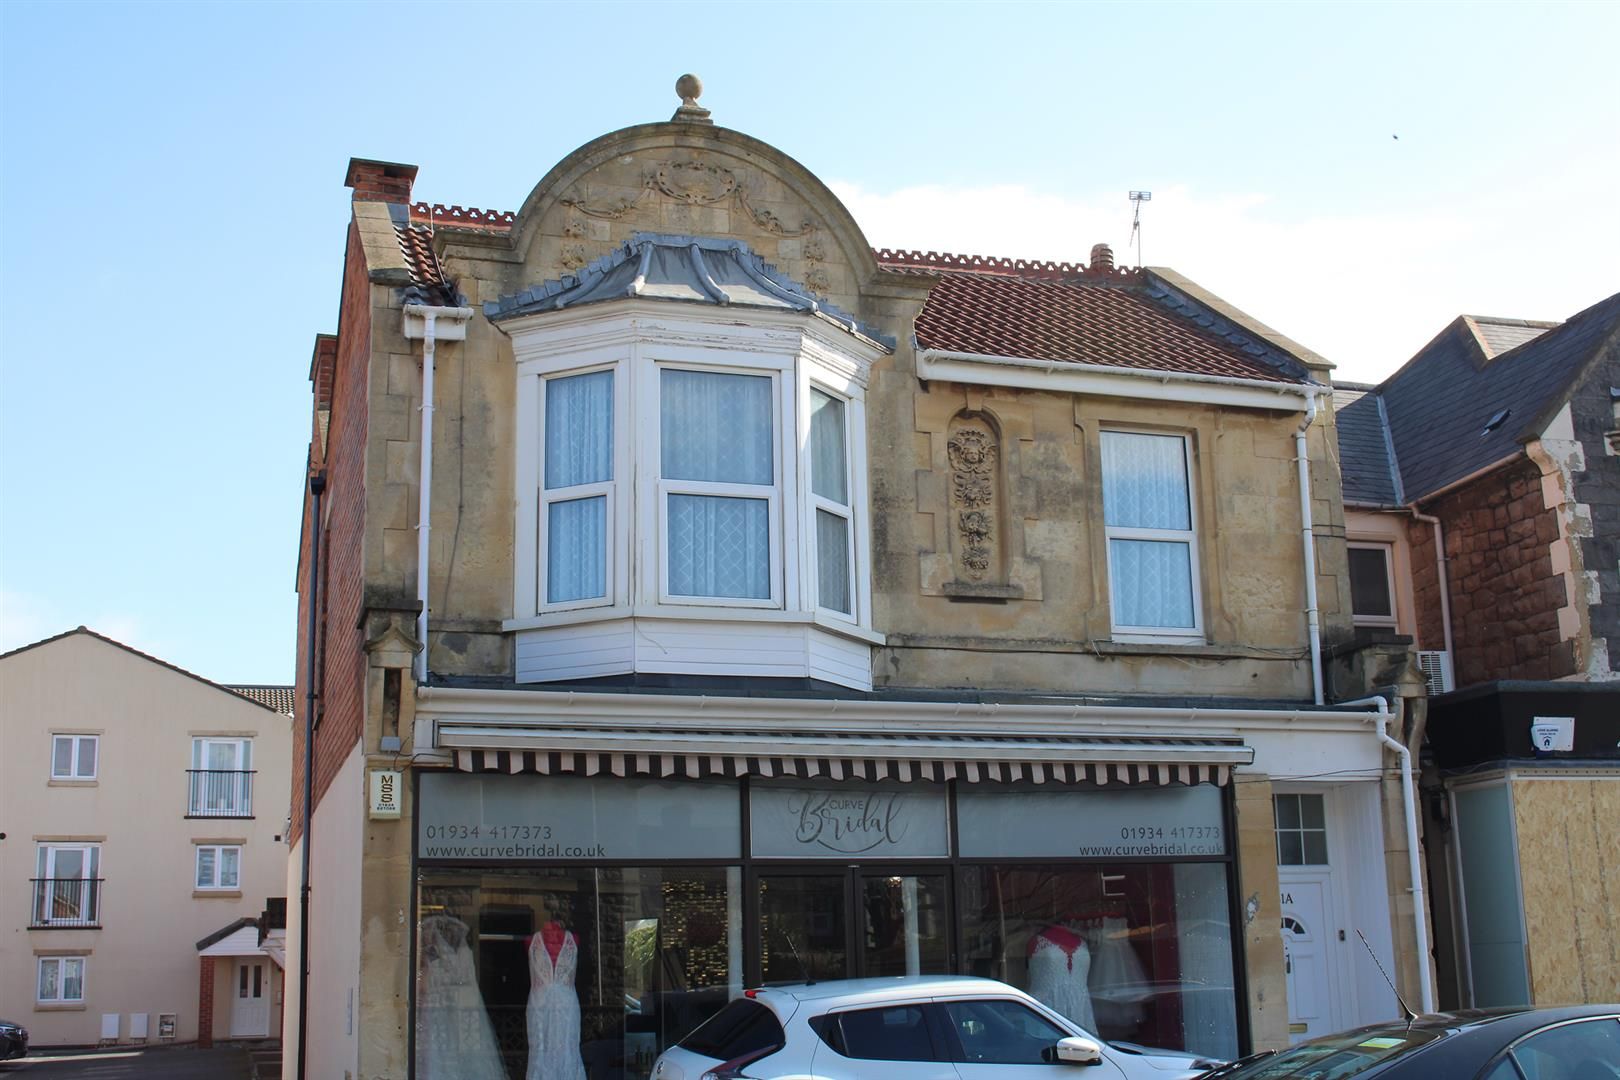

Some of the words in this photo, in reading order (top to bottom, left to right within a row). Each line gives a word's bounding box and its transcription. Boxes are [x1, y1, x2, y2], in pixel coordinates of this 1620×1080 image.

[381, 774, 393, 803] MSS
[829, 800, 864, 810] CURVE
[788, 790, 909, 844] Bridal
[426, 825, 480, 840] 01934
[489, 825, 553, 840] 417373
[1121, 827, 1163, 840] 01934
[1170, 826, 1220, 840] 417373
[426, 843, 606, 857] www.curvebridal.co.uk
[1079, 843, 1224, 856] www.curvebridal.co.uk
